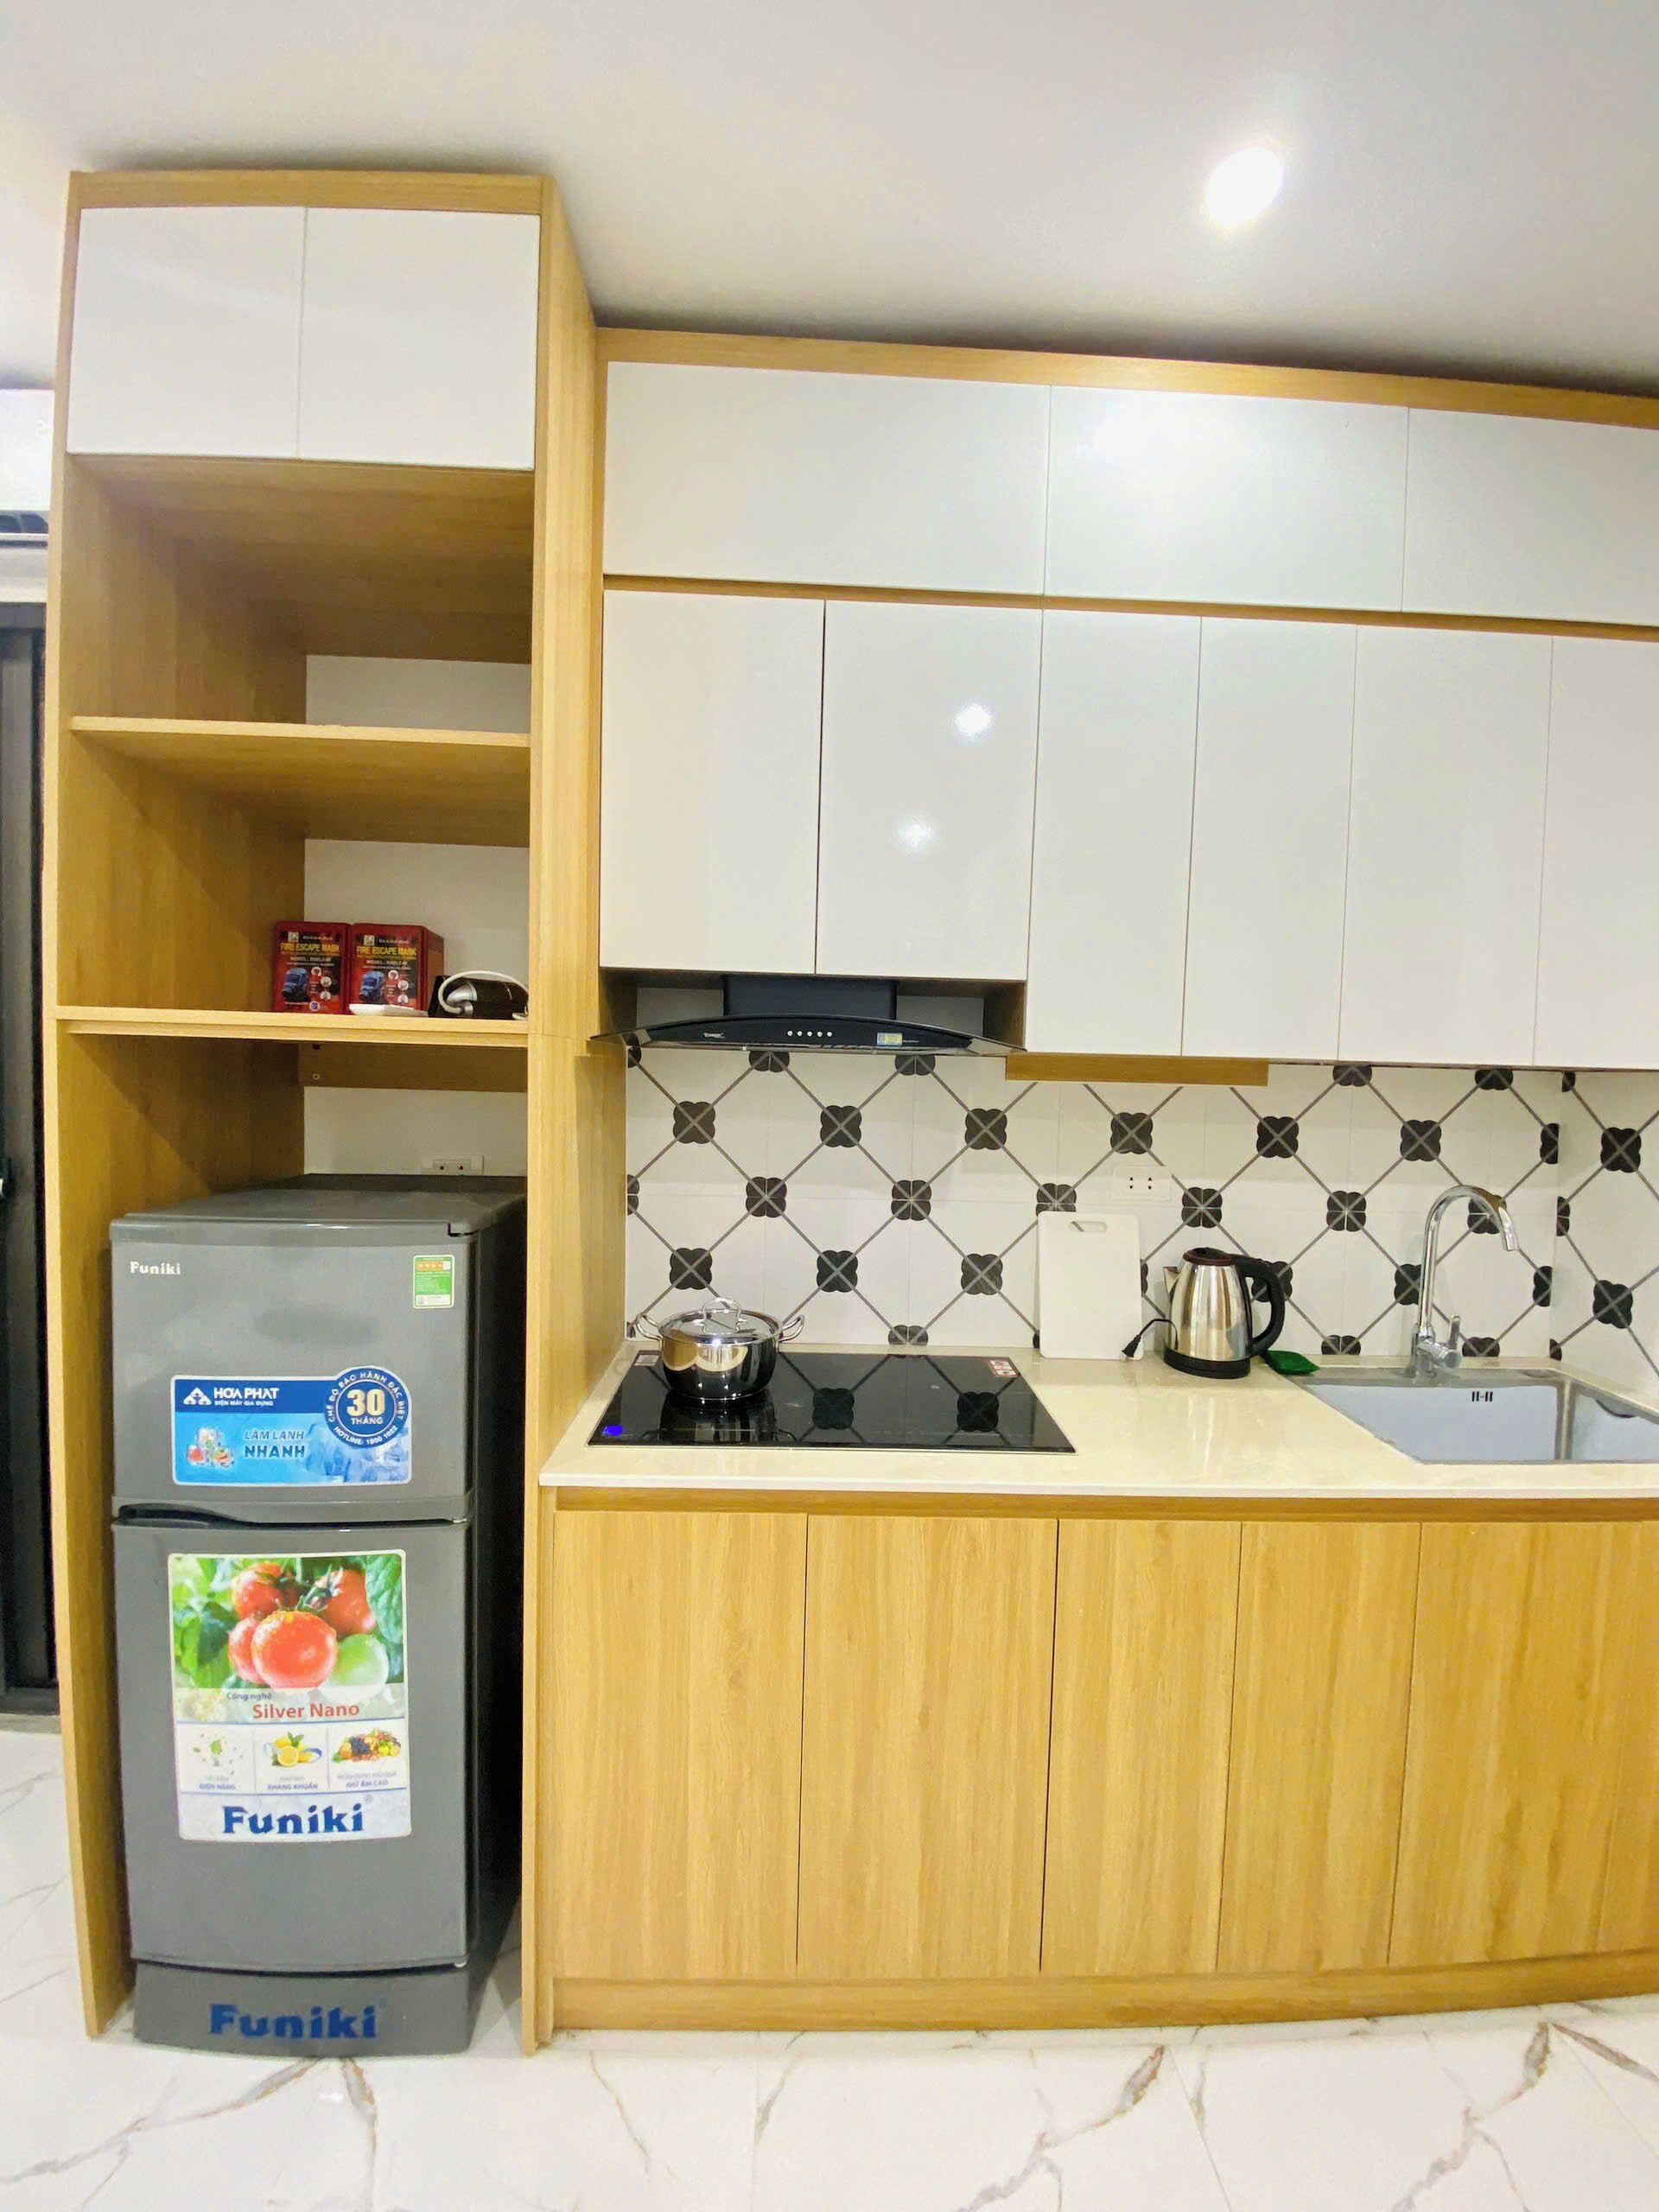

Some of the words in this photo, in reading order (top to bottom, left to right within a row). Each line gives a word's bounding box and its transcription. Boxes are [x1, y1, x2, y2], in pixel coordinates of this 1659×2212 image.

[280, 943, 295, 951] FIRE
[296, 943, 321, 952] ESCAPE
[321, 944, 340, 953] MASK
[356, 945, 372, 955] FIRE
[372, 946, 397, 955] ESCAPE
[398, 946, 417, 956] MASK
[130, 1261, 181, 1274] Funiki
[346, 1389, 385, 1416] 30
[351, 1415, 384, 1425] THÁNG
[245, 1445, 305, 1458] NHANH
[252, 1703, 305, 1719] Silver
[309, 1702, 360, 1718] Nano
[222, 1802, 365, 1834] Funiki
[209, 2003, 377, 2038] Funiki
